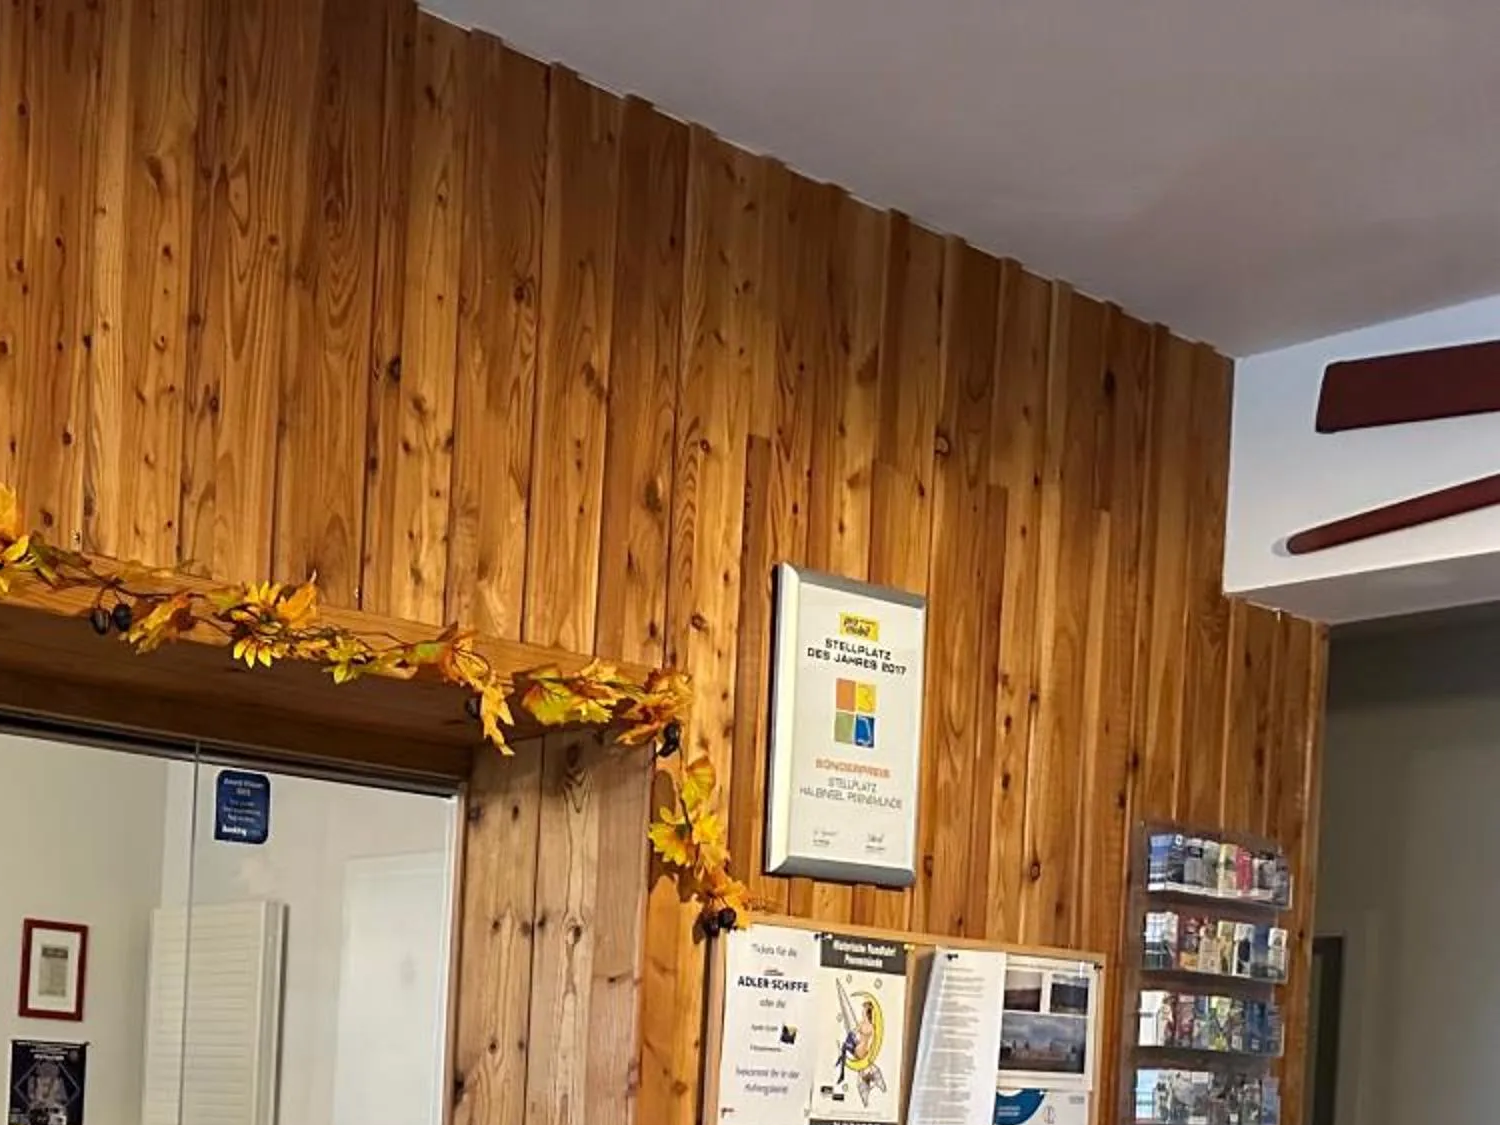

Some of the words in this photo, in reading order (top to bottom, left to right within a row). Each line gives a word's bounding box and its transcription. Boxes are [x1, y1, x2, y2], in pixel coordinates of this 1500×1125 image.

[807, 647, 831, 660] DES
[834, 653, 878, 671] JAHRES
[882, 661, 907, 675] 2017
[825, 638, 891, 660] STELLPLATZ
